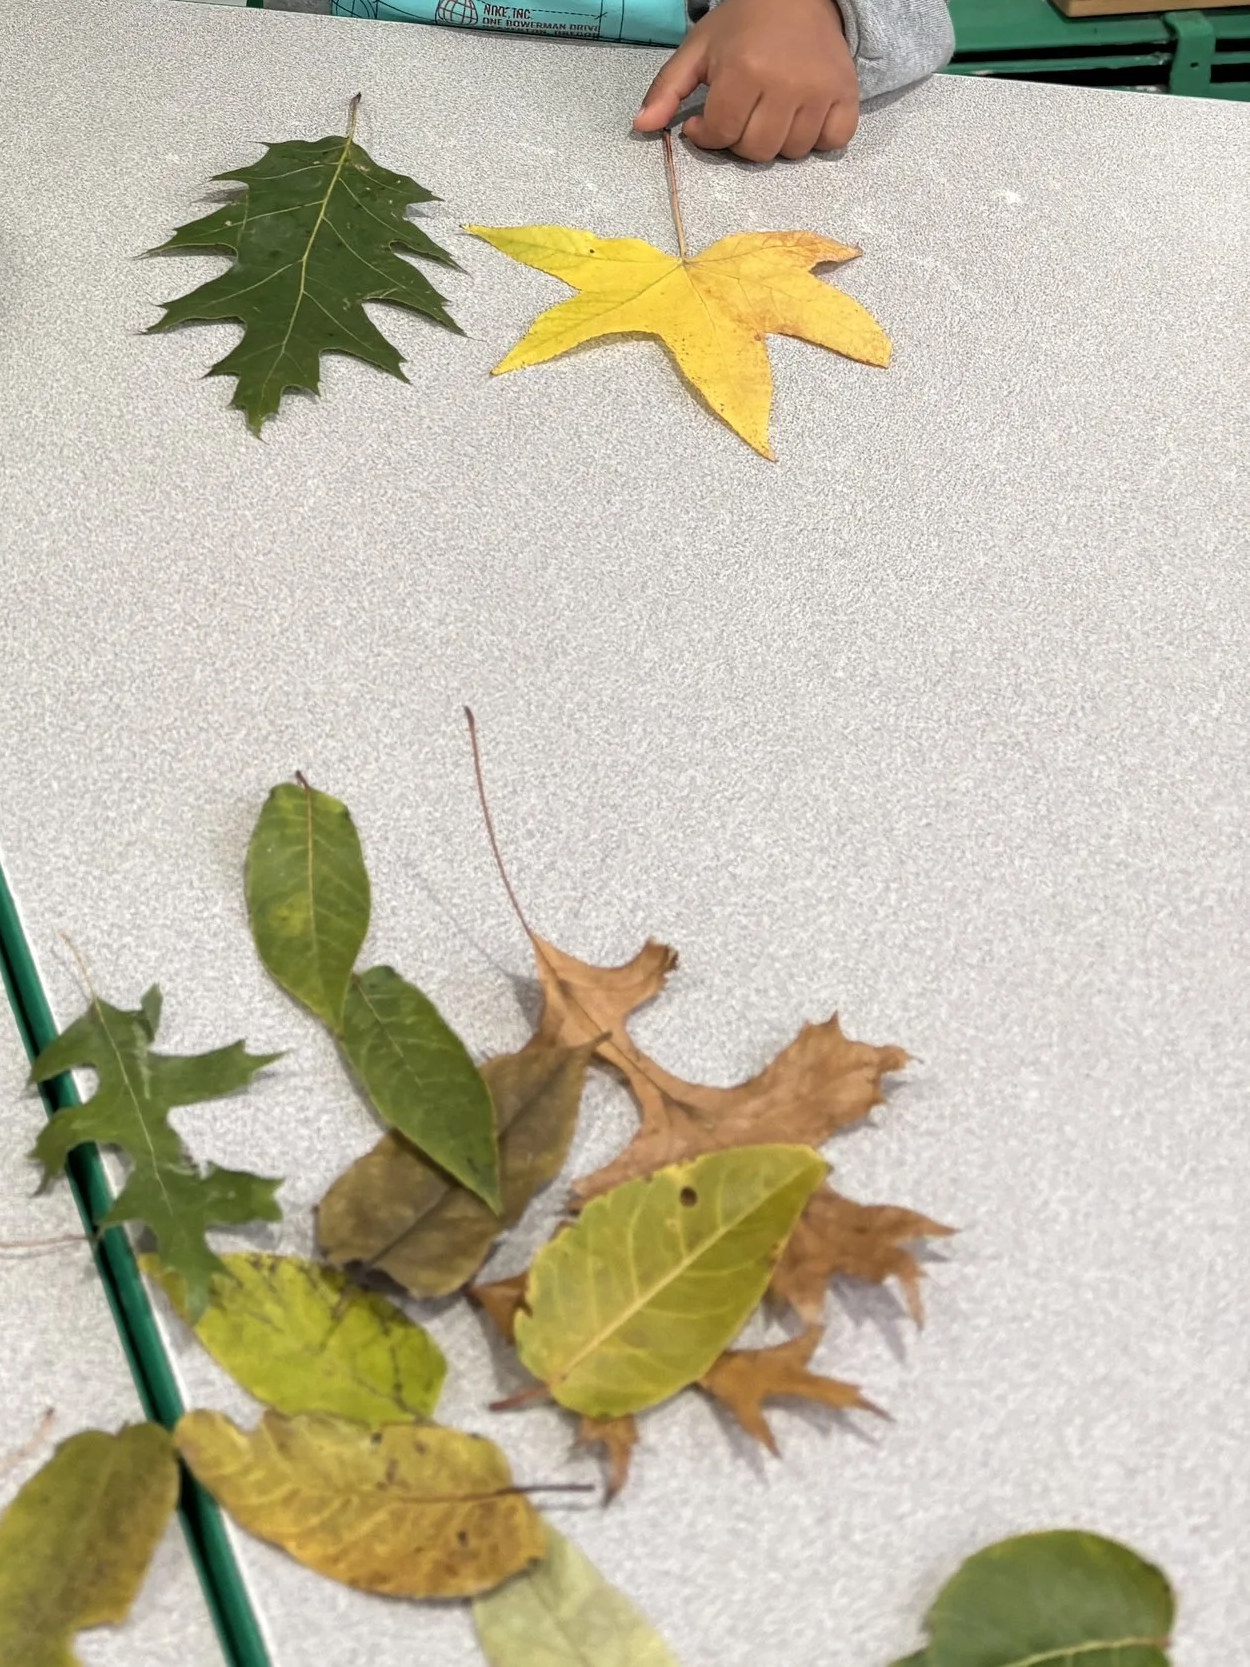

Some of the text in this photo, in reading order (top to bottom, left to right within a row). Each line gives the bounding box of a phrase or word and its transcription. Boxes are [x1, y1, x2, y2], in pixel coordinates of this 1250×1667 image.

[483, 4, 534, 20] NIKE, INC.
[482, 17, 503, 25] ONE
[505, 19, 566, 30] BOWERMAN
